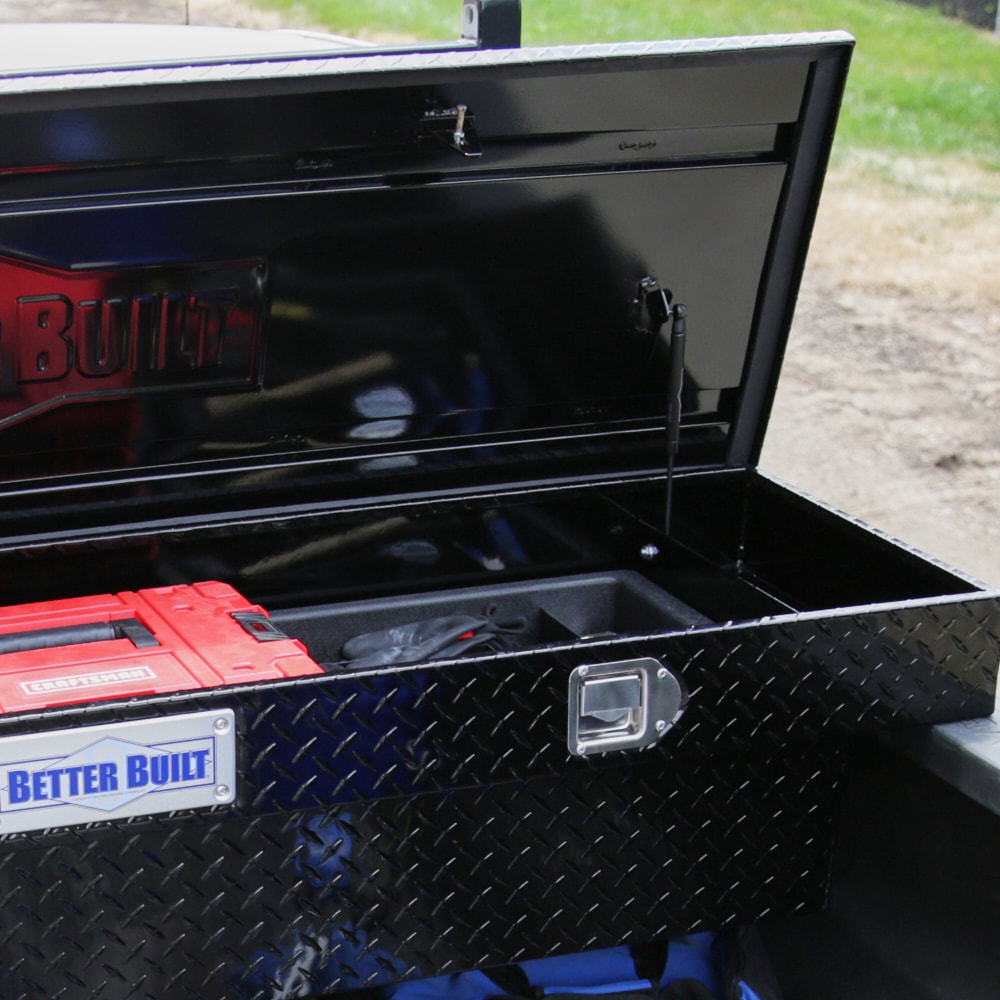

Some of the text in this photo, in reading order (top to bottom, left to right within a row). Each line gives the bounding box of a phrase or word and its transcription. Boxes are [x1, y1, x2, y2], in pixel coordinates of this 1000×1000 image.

[16, 287, 239, 384] BUILT
[30, 670, 145, 691] CRAFTSMAN
[8, 749, 209, 804] BETTER BUILT
